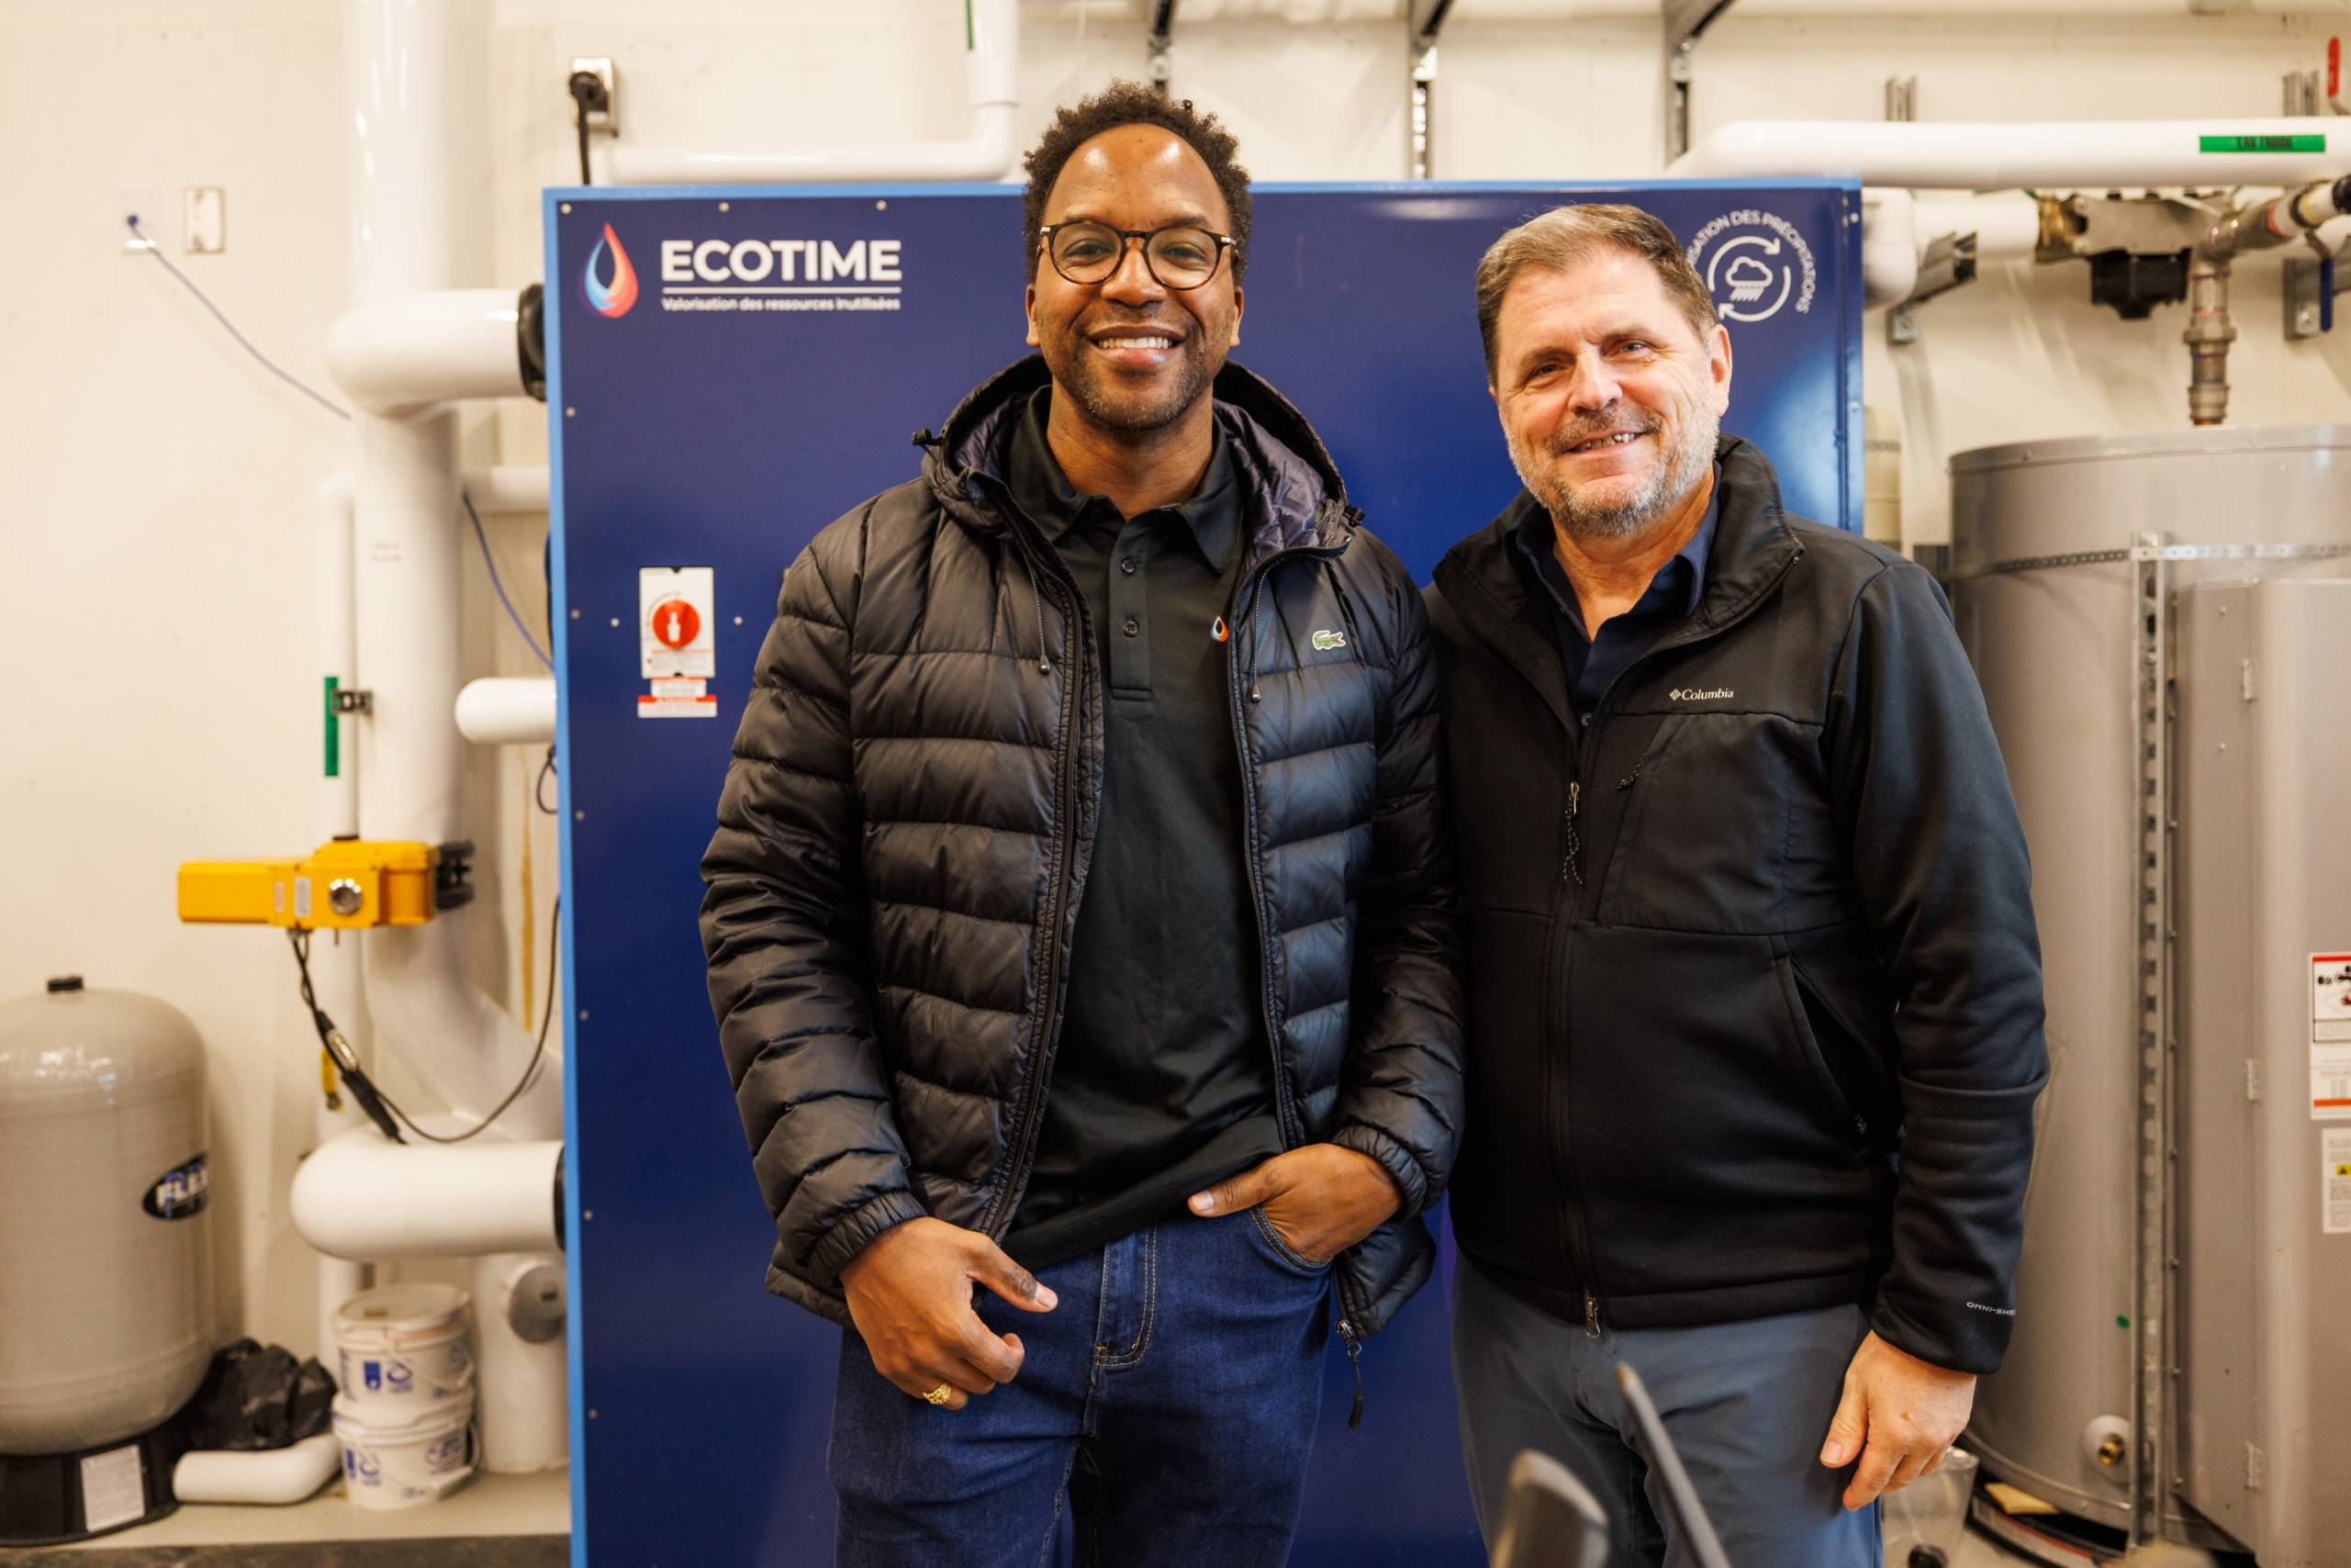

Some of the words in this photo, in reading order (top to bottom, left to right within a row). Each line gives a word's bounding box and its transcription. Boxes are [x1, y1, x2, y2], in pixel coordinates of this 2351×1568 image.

[1730, 209, 1762, 226] DES
[661, 239, 902, 283] ECOTIME
[660, 297, 738, 311] Valorisation
[739, 297, 764, 311] des
[764, 298, 834, 311] ressources
[1681, 688, 1734, 700] Columbia
